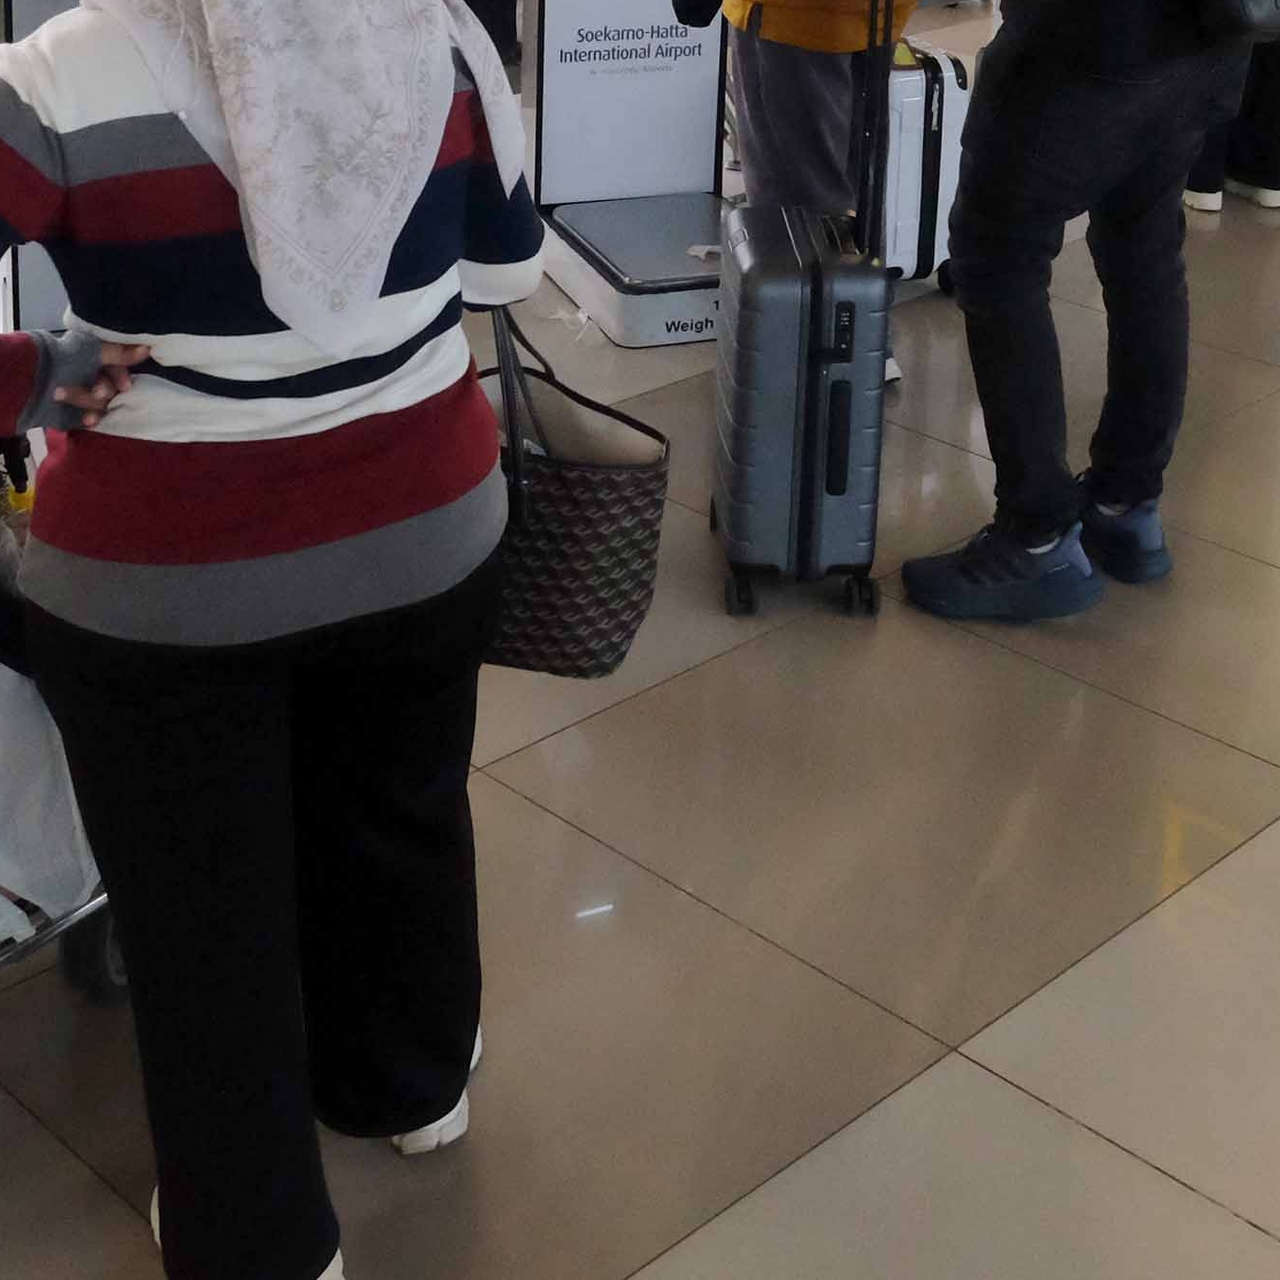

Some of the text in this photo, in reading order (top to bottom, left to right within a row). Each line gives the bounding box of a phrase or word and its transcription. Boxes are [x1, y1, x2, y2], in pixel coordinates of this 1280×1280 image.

[577, 24, 688, 42] Soekarno-Hatta
[559, 42, 702, 63] International Airport
[665, 317, 714, 333] Weigh
